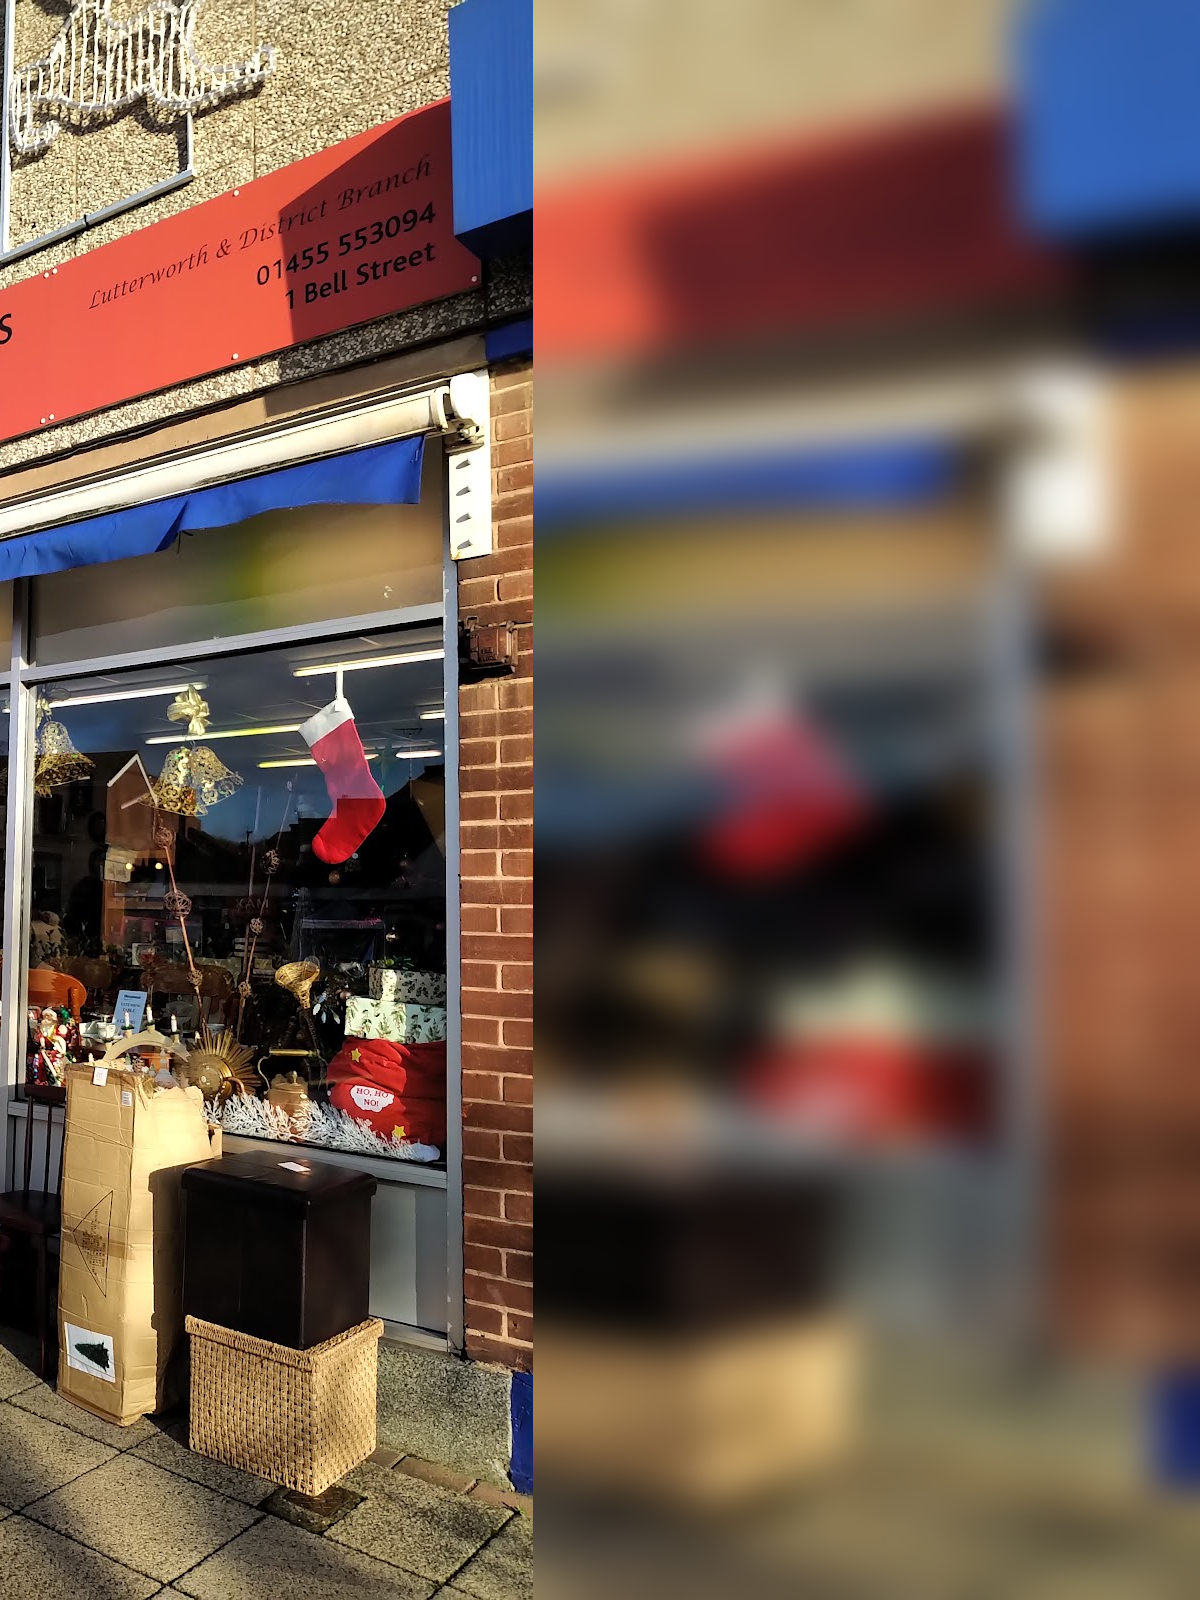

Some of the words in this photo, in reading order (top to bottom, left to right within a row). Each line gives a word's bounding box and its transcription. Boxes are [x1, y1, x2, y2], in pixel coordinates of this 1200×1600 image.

[88, 244, 209, 310] Lutterworth
[216, 238, 232, 259] &
[238, 199, 328, 250] District
[337, 153, 431, 211] Branch
[256, 241, 330, 286] 01455
[338, 201, 436, 257] 553094
[285, 289, 295, 310] 1
[304, 269, 349, 304] Bell
[356, 242, 436, 286] Street
[363, 1099, 379, 1107] NO!
